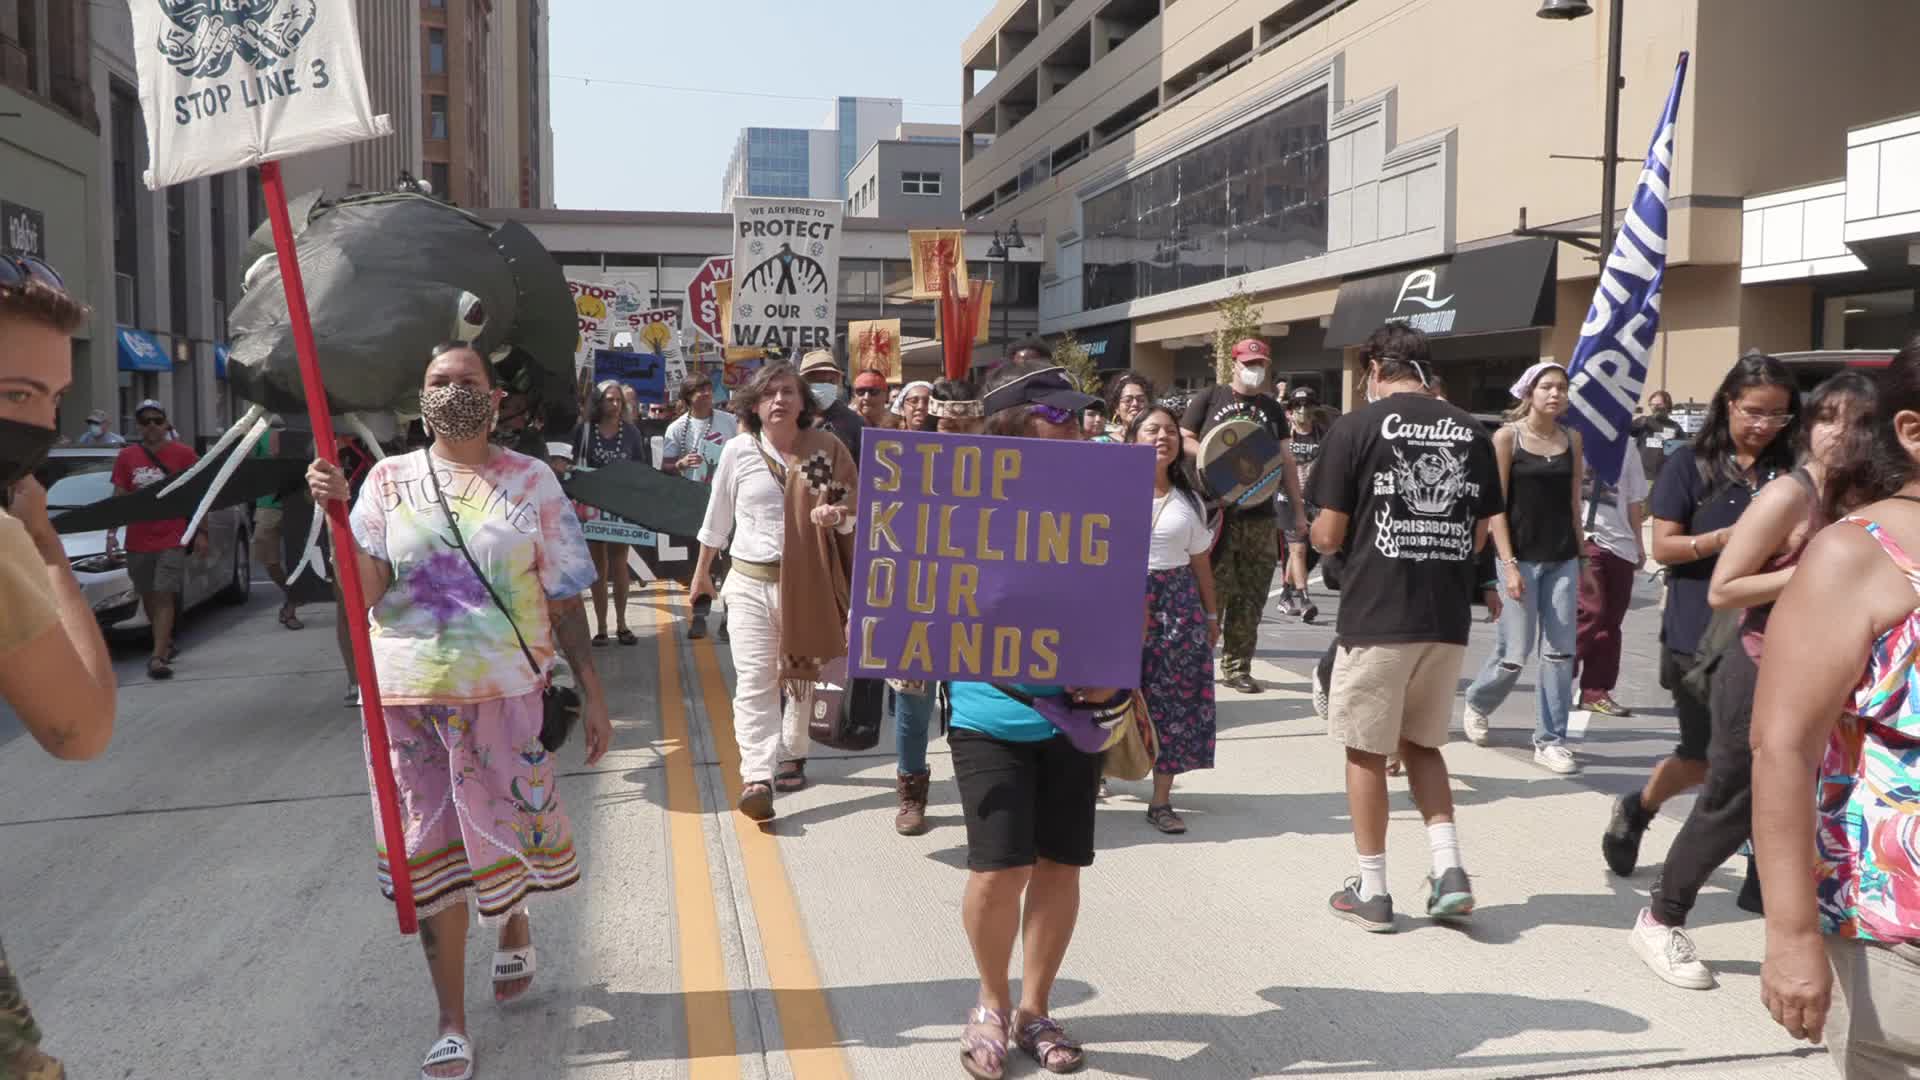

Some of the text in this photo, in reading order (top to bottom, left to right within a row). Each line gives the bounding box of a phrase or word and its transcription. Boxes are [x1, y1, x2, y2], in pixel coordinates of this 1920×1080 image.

[175, 58, 329, 125] STOP LINE 3
[750, 206, 825, 217] WE ARE HERE TO
[739, 219, 834, 240] PROTECT
[568, 281, 617, 300] STOP
[628, 309, 676, 327] STOP
[764, 304, 800, 318] OUR
[734, 324, 831, 347] WATER
[1381, 413, 1474, 442] Carnitas
[873, 440, 1022, 500] STOP
[1374, 471, 1394, 485] 24
[1374, 485, 1395, 496] HRS
[869, 501, 1111, 566] KILLING
[866, 557, 980, 617] OUR
[859, 616, 1060, 680] LANDS
[495, 962, 524, 975] PUMA
[427, 1046, 458, 1062] PUMA
